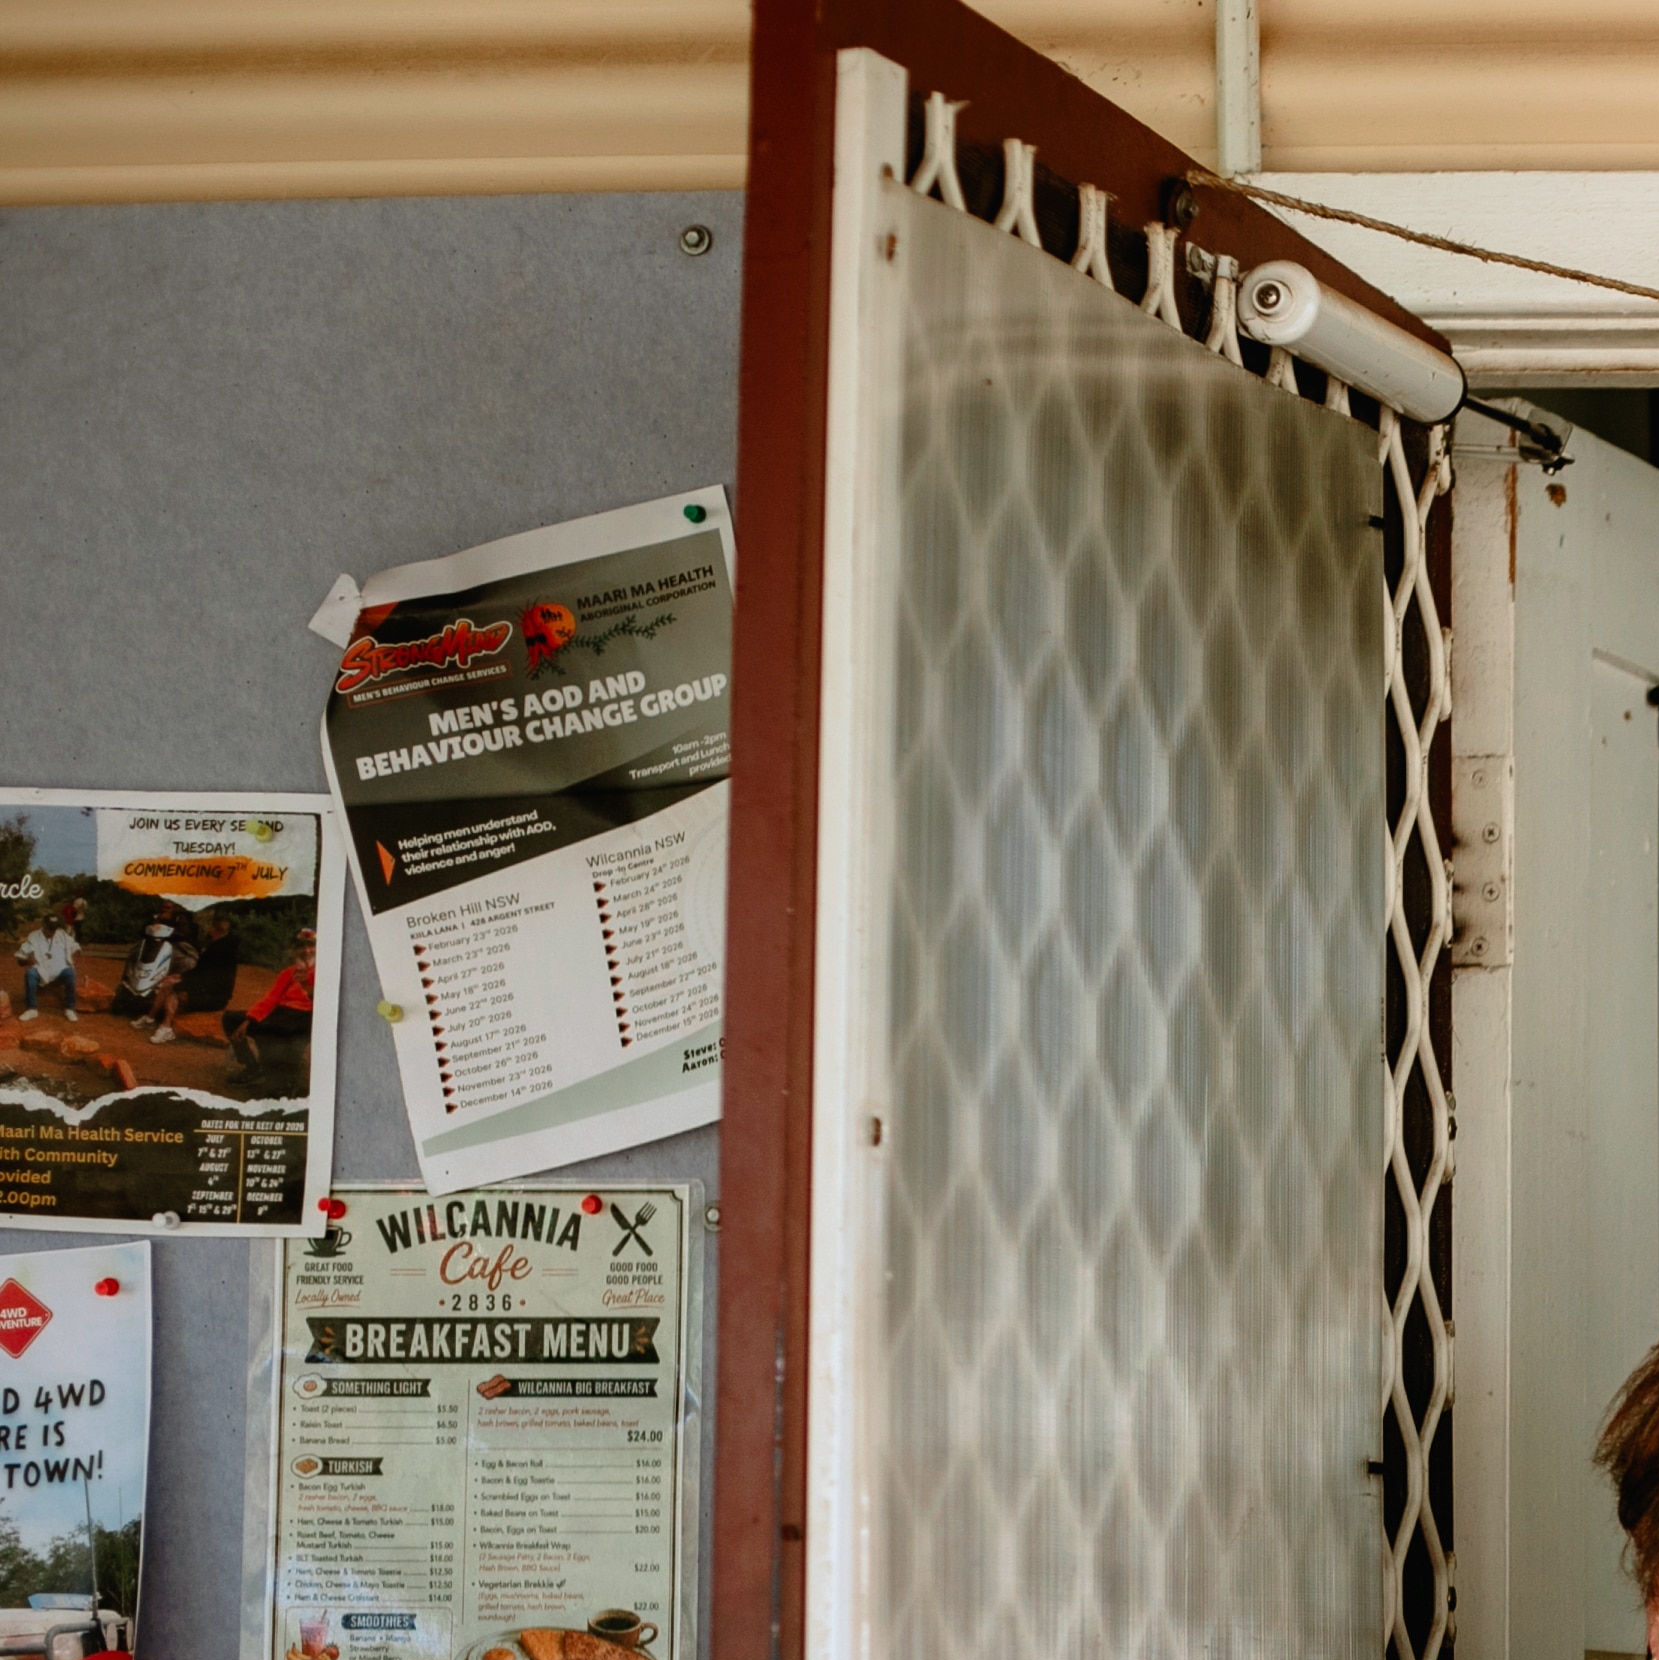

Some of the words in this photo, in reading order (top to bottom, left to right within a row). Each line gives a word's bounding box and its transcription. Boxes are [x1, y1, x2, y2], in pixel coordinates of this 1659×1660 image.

[575, 587, 627, 610] MAARI
[628, 580, 654, 597] MA
[655, 565, 714, 591] HEALTH
[579, 600, 643, 623] ABORIGINAL
[643, 581, 717, 607] CORPORATION
[352, 690, 381, 703] MEN'S
[381, 680, 430, 697] BEHAVIOUR
[430, 673, 465, 688] CHANGE
[466, 664, 508, 681] SERVICES
[428, 698, 519, 736] MEN'S
[521, 684, 582, 716] AOD
[585, 670, 645, 702] AND
[355, 722, 521, 781] BEHAVIOUR
[523, 696, 634, 742] CHANGE
[637, 675, 728, 716] GROUP
[627, 756, 680, 782] Transport
[678, 749, 699, 763] and
[698, 739, 730, 757] Lunch
[689, 752, 732, 777] provided
[129, 817, 159, 830] JOIN
[164, 818, 181, 830] US
[185, 819, 227, 832] EVERY
[231, 820, 284, 833] SEND
[397, 831, 443, 852] Helping
[444, 827, 470, 840] men
[471, 809, 539, 833] understand
[173, 841, 236, 855] TUESDAY!
[401, 848, 429, 863] their
[429, 833, 499, 858] relationship
[499, 827, 525, 841] with
[526, 820, 556, 837] AOD,
[585, 840, 652, 868] Wilcannia
[652, 830, 687, 849] NSW
[405, 856, 454, 876] violence
[455, 851, 478, 865] and
[478, 843, 517, 862] anger!
[124, 862, 221, 879] COMMENCING
[227, 861, 247, 880] 7TH
[252, 866, 288, 881] JULY
[0, 874, 44, 899] rcle
[405, 906, 457, 928] Broken
[458, 900, 483, 916] Hill
[484, 891, 521, 911] NSW
[683, 1041, 717, 1060] Steve:
[682, 1053, 719, 1073] Aaron:
[39, 1126, 63, 1139] Ma
[68, 1126, 120, 1141] Health
[125, 1128, 184, 1143] Service
[225, 1120, 239, 1129] FOR
[241, 1121, 255, 1130] THE
[275, 1121, 284, 1131] OF
[286, 1122, 304, 1131] 2026
[0, 1147, 20, 1160] ith
[24, 1148, 118, 1167] Community
[0, 1169, 51, 1184] ovided
[376, 1199, 583, 1254] WILCANNIA
[304, 1262, 332, 1272] GREAT
[332, 1262, 353, 1272] FOOD
[439, 1241, 533, 1292] Cafe
[610, 1262, 632, 1272] GOOD
[635, 1262, 658, 1272] FOOD
[296, 1275, 331, 1285] FRIENDLY
[333, 1275, 364, 1285] SERVICE
[606, 1275, 629, 1285] GOOD
[631, 1275, 663, 1285] PEOPLE
[295, 1290, 329, 1307] Locally
[331, 1289, 360, 1303] Owned
[451, 1294, 512, 1312] 2836
[602, 1289, 633, 1305] Great
[634, 1289, 665, 1304] Place
[0, 1316, 43, 1330] VENTURE
[345, 1323, 532, 1359] BREAKFAST
[543, 1323, 630, 1359] MENU
[34, 1379, 106, 1414] 4WD
[331, 1381, 390, 1395] SOMETHING
[393, 1381, 423, 1394] LIGHT
[518, 1381, 573, 1395] WILCANNIA
[575, 1381, 592, 1395] BIG
[594, 1381, 651, 1395] BREAKFAST
[42, 1420, 66, 1447] IS
[627, 1429, 663, 1443] $24.00
[4, 1449, 103, 1489] TOWN!
[328, 1460, 373, 1473] TURKISH
[478, 1579, 521, 1590] Vegetarian
[524, 1579, 554, 1588] Brekkie
[350, 1616, 410, 1628] SMOOTHIES
